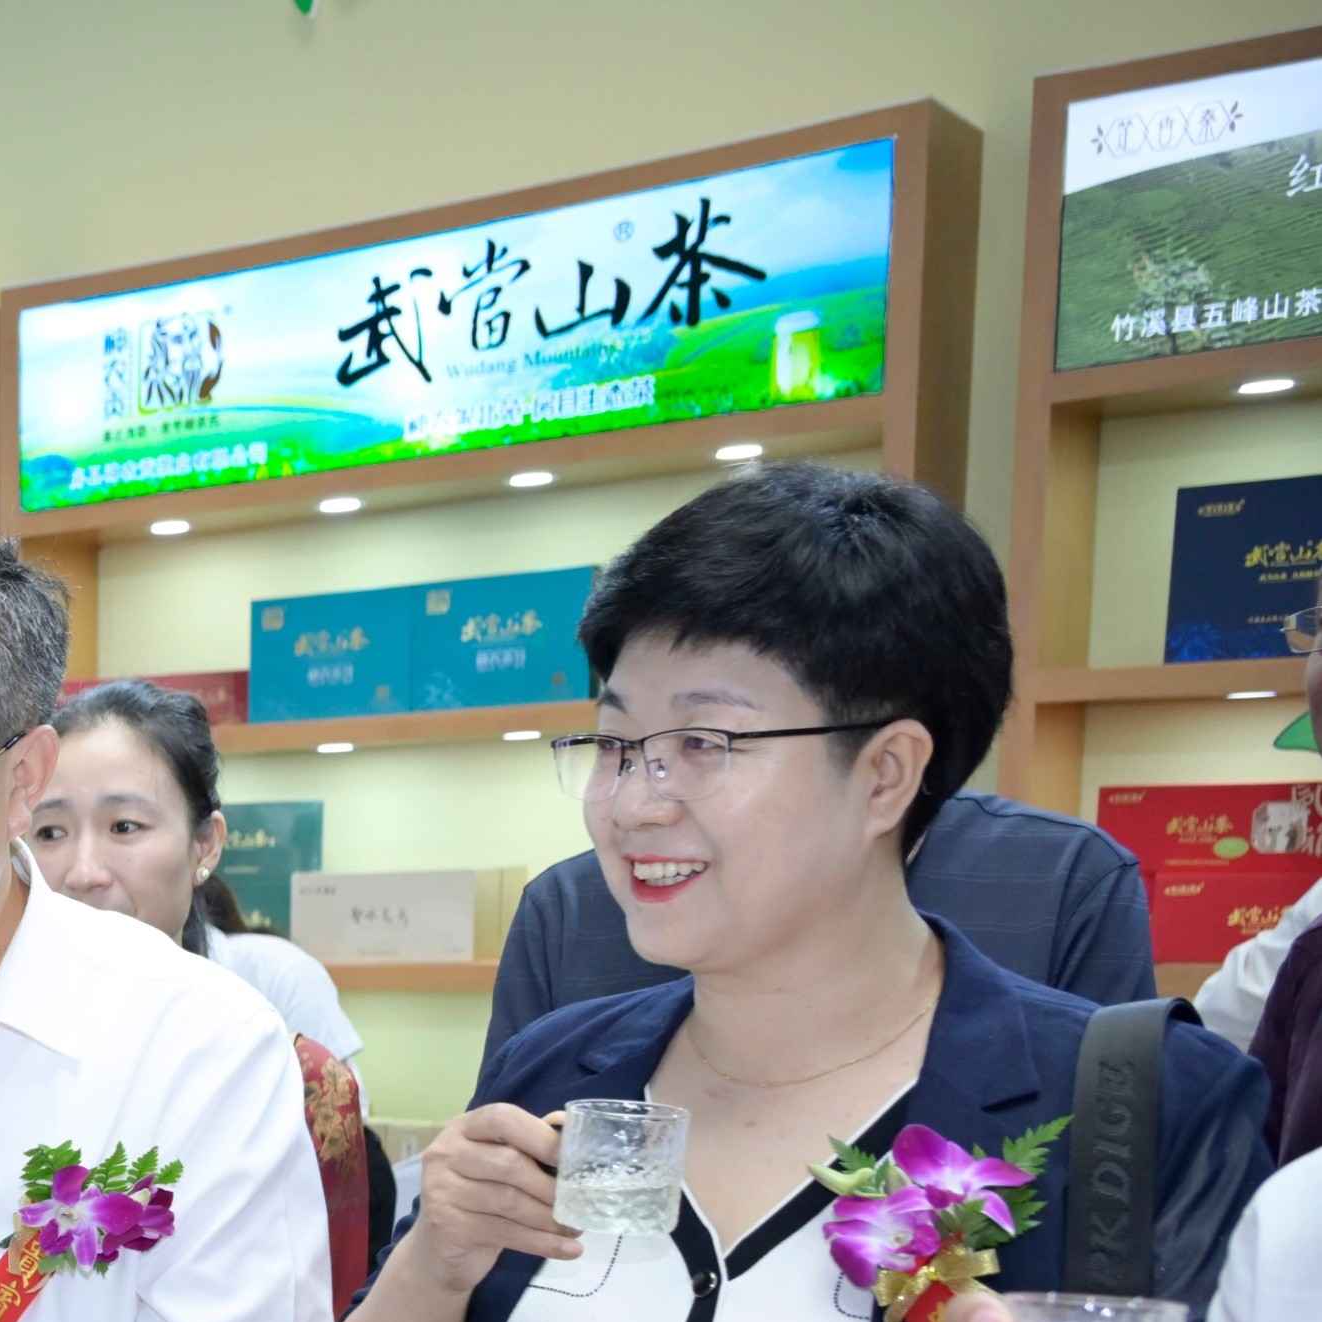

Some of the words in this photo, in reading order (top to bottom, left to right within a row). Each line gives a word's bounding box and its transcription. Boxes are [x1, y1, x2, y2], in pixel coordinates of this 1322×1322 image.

[336, 196, 768, 388] 武當山茶
[1110, 286, 1322, 343] 竹溪县五峰山茶
